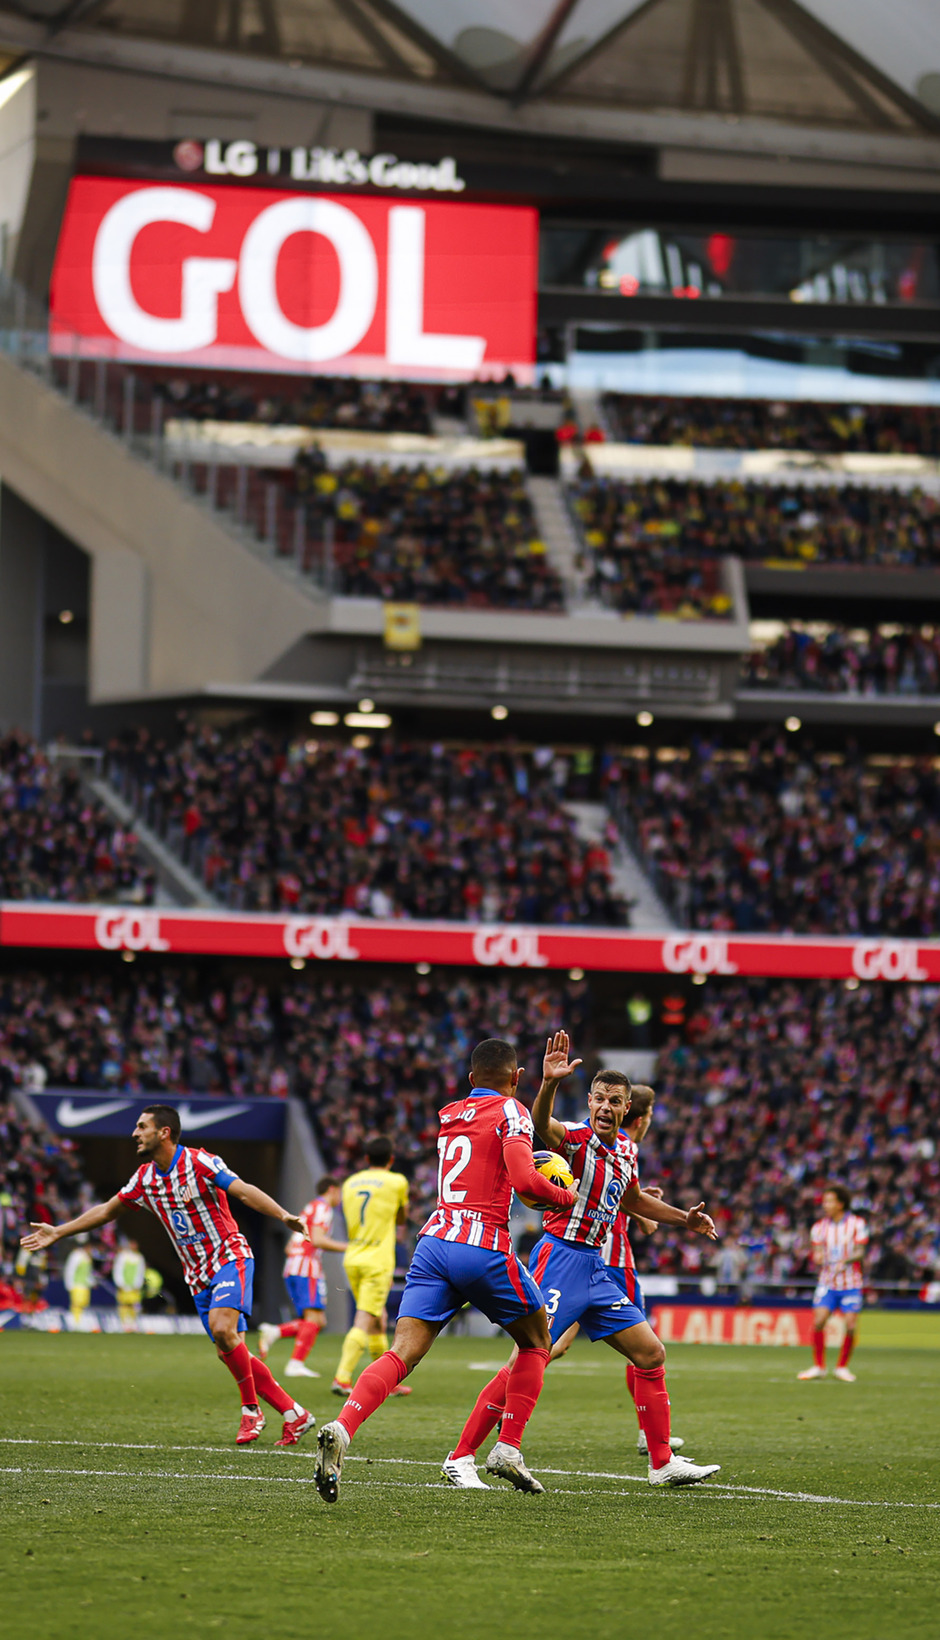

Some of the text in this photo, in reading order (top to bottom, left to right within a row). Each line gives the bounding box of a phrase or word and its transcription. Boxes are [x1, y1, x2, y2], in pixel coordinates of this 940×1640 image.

[205, 139, 257, 176] LG
[291, 146, 369, 185] Life's
[92, 186, 486, 368] GOL
[95, 910, 928, 981] GOL GOL GOL GOL GOL
[437, 1135, 473, 1204] 12
[356, 1190, 371, 1227] 7
[659, 1308, 799, 1347] LALIGA
